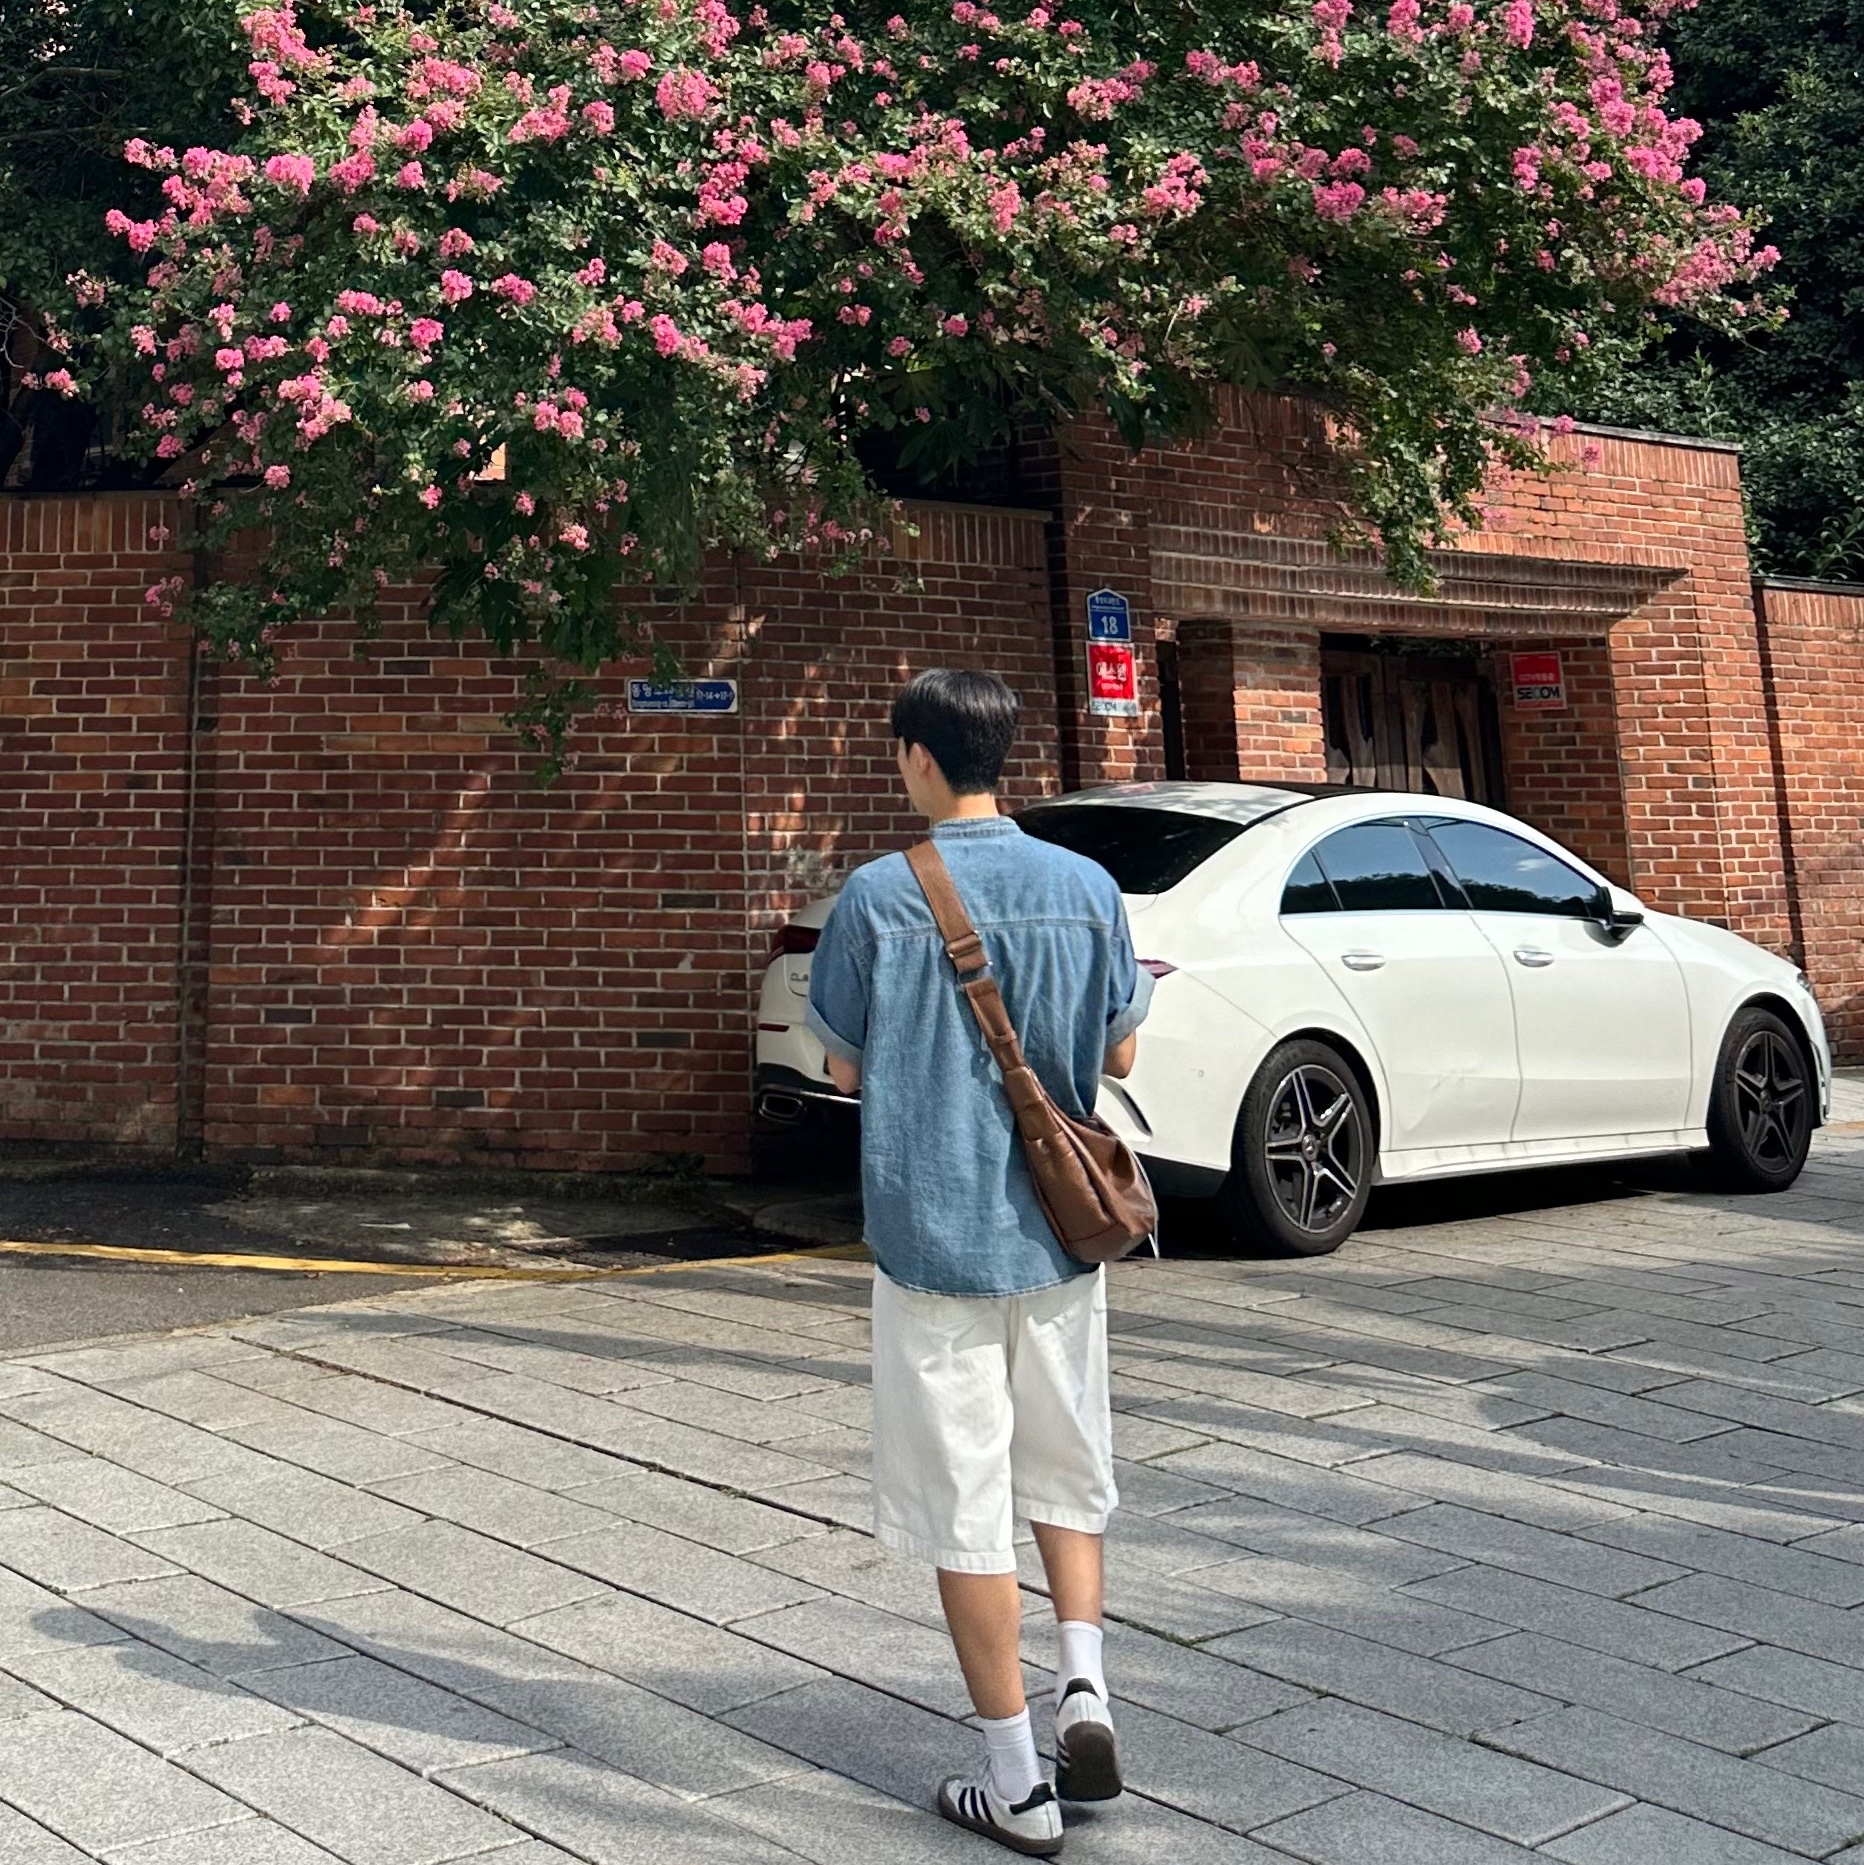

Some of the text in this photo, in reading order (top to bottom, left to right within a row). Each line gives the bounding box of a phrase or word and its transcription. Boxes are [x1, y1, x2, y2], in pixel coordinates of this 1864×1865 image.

[1101, 615, 1119, 635] 18
[1096, 661, 1127, 682] 에스원
[1517, 686, 1561, 700] SECOM
